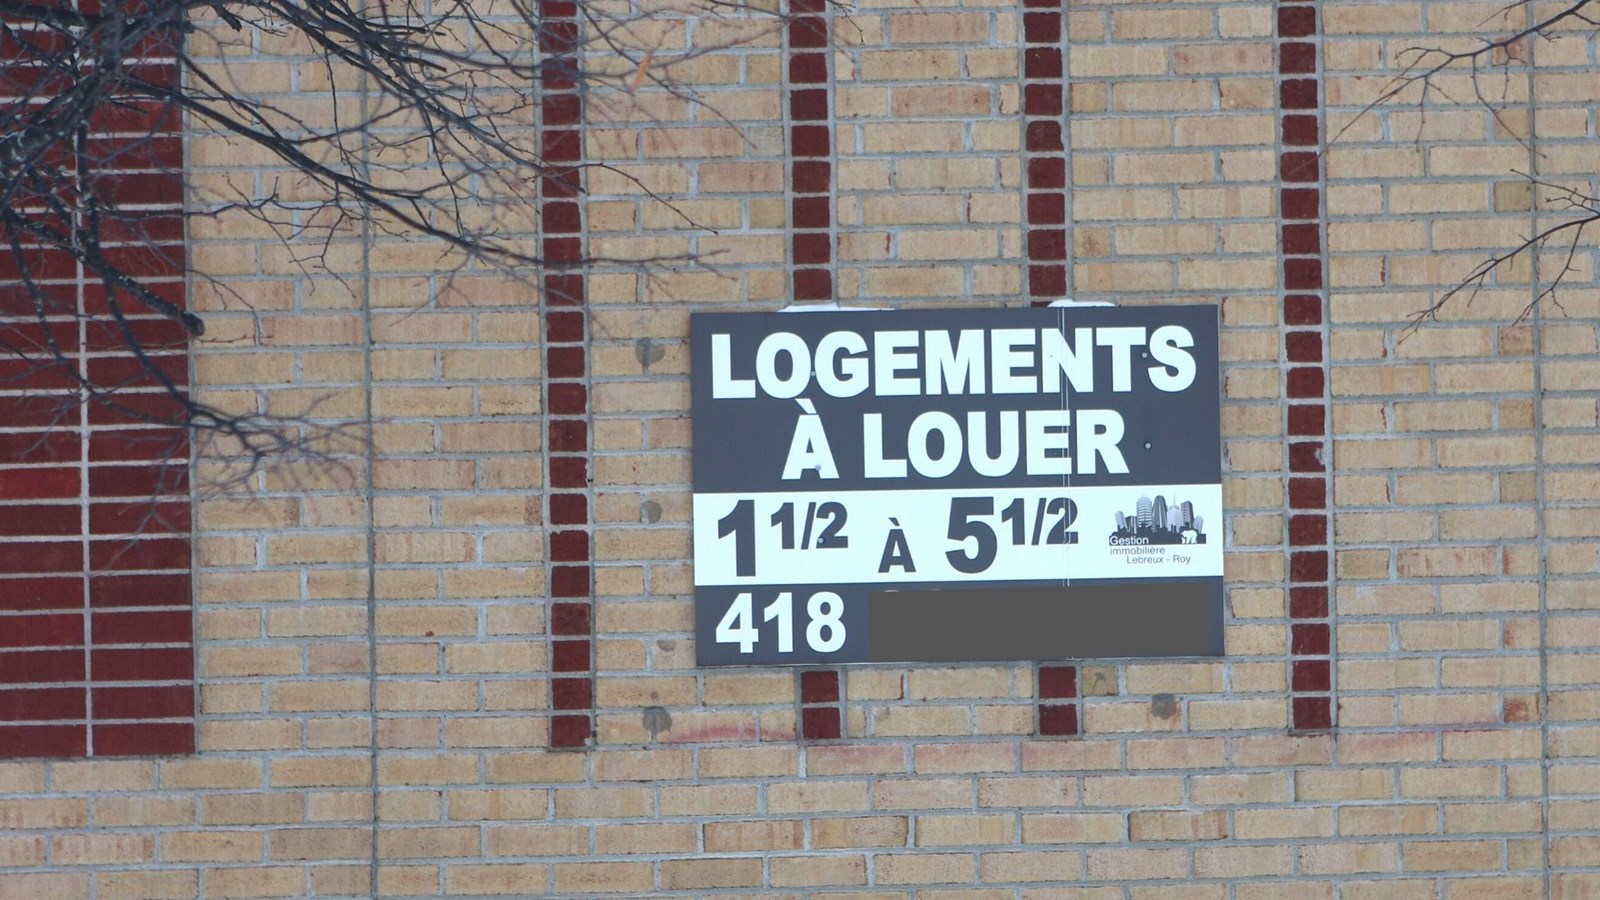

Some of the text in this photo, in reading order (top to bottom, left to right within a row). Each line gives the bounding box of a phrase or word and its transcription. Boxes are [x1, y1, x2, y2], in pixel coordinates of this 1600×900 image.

[711, 325, 1197, 399] LOGEMENTS
[781, 399, 1130, 480] À LOUER
[878, 517, 917, 574] À
[1109, 535, 1149, 546] Gestion
[1109, 547, 1166, 555] immobilière
[1126, 556, 1164, 564] Lebreux
[1172, 555, 1191, 565] Roy
[715, 592, 847, 654] 418
